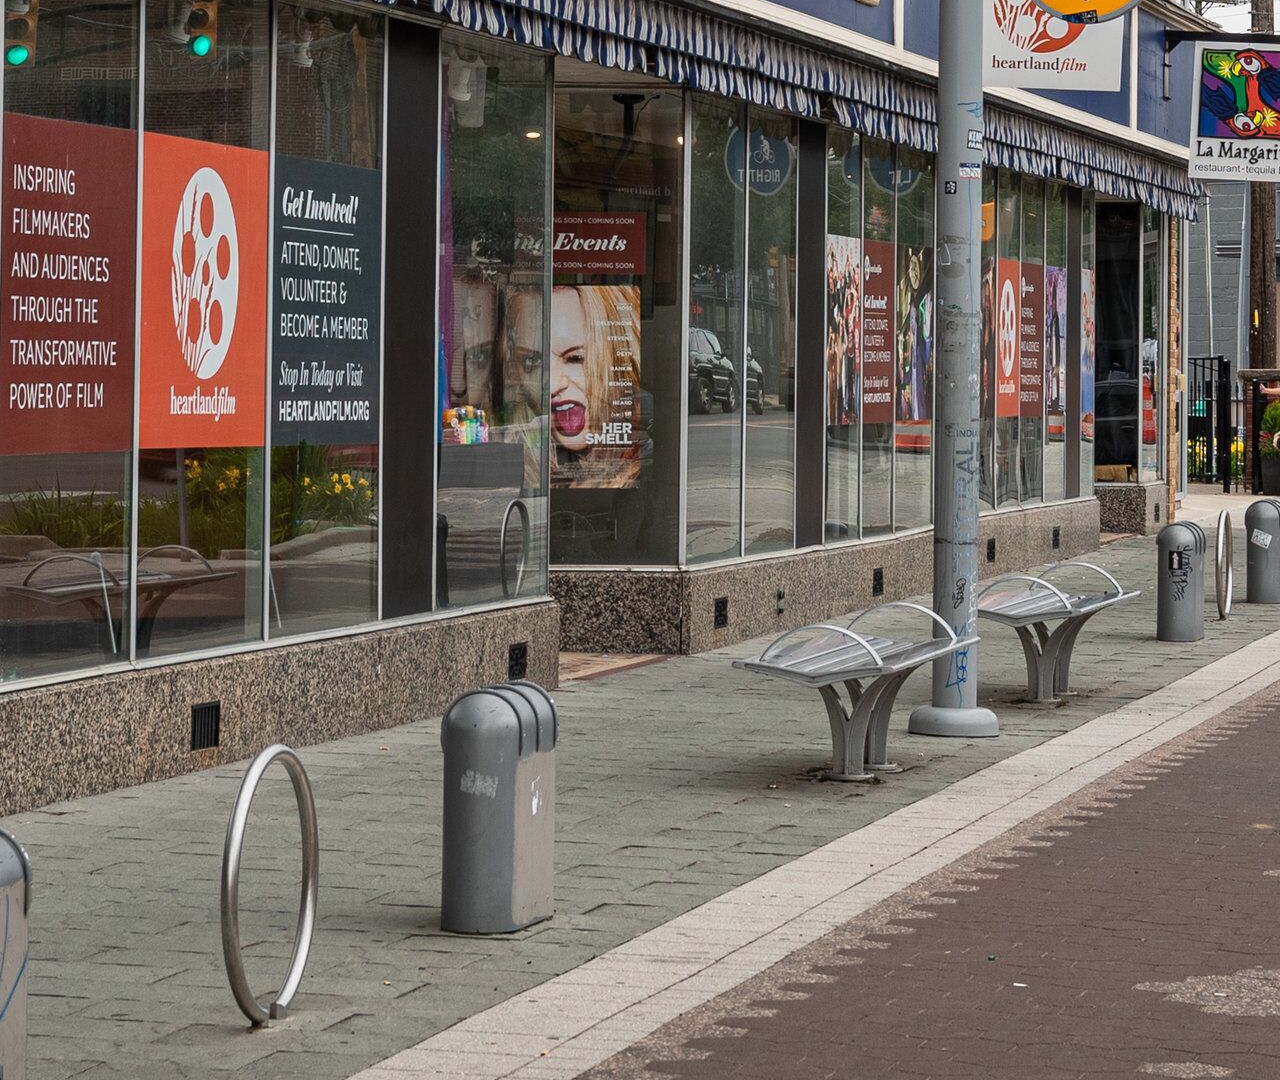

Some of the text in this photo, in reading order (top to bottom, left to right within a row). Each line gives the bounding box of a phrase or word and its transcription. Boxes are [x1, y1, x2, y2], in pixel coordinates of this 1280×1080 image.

[991, 55, 1087, 74] heartlandfilm
[1196, 140, 1213, 157] La
[13, 163, 76, 196] INSPIRING
[1245, 165, 1276, 176] tequila
[281, 186, 359, 225] Get Involved!
[12, 208, 90, 239] FILMMAKERS
[553, 232, 627, 251] Events
[11, 252, 110, 283] AND AUDIENCES
[281, 240, 362, 276] ATTEND, DONATE,
[280, 277, 346, 304] VOLUNTEER &
[11, 295, 98, 324] THROUGH THE
[280, 313, 369, 341] BECOME A MEMBER
[10, 339, 117, 367] TRANSFORMATIVE
[279, 360, 364, 392] Stop In Today or Visit
[9, 383, 104, 409] POWER OF FILM
[170, 385, 236, 422] heartlandfilm
[279, 400, 370, 422] HEARTLANDFILM.ORG
[585, 433, 633, 445] SMELL
[602, 422, 632, 433] HER
